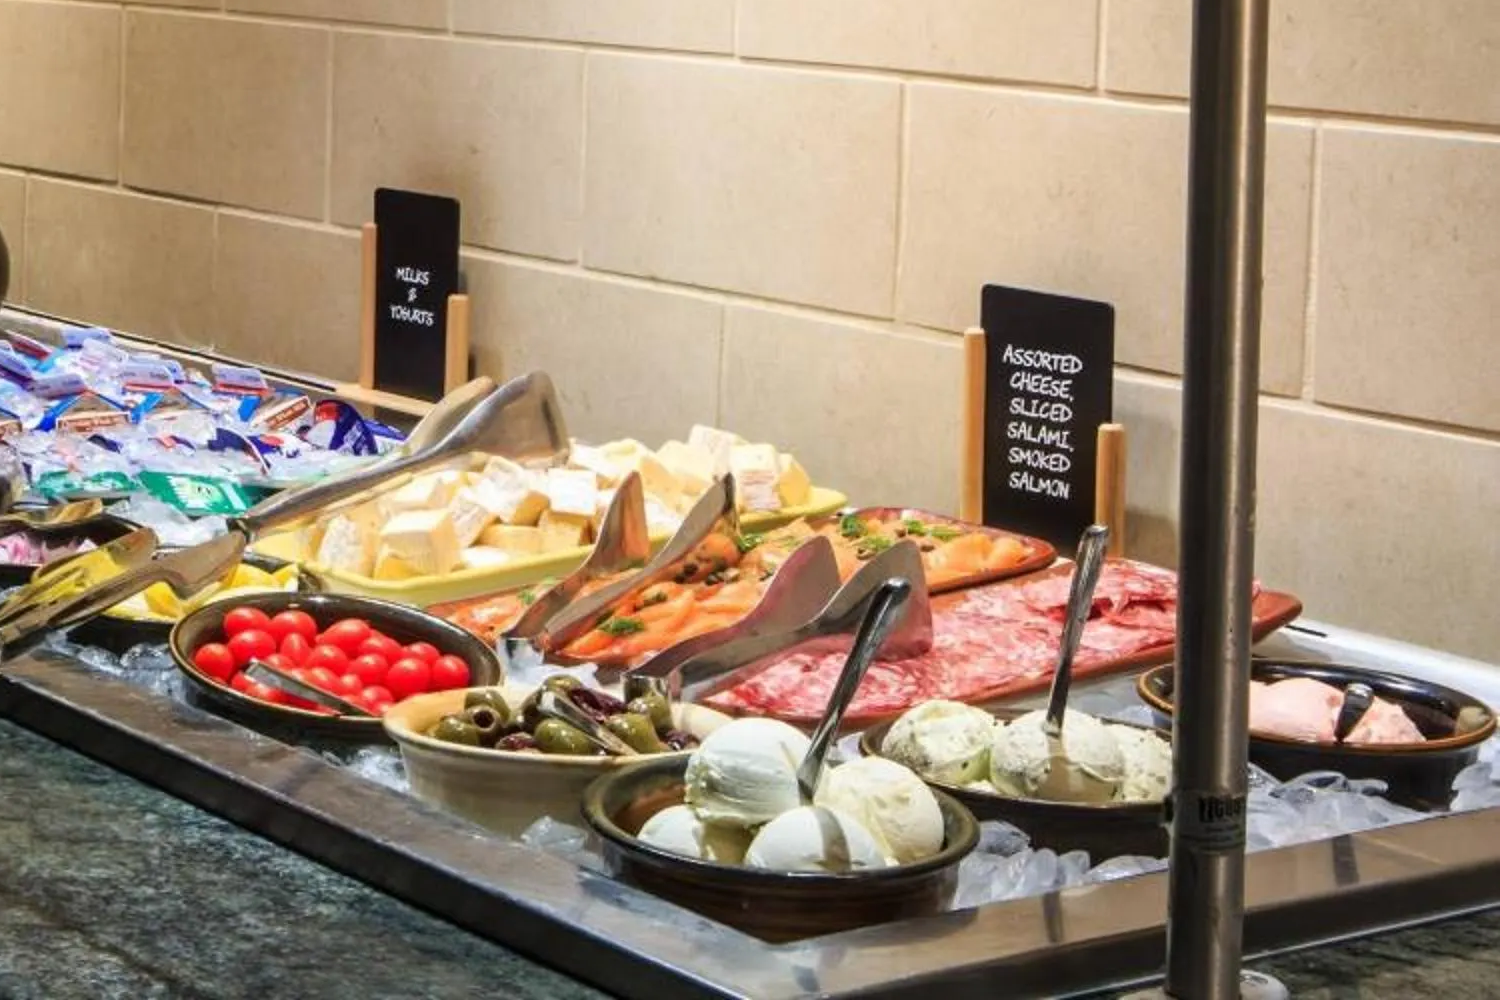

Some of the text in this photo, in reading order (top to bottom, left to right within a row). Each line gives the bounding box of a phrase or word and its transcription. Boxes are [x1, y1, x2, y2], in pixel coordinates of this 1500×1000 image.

[396, 267, 430, 285] MILKS
[389, 305, 435, 327] YOGURTS
[1002, 344, 1084, 374] ASSORTED
[1010, 372, 1074, 402] CHEESE,
[1009, 398, 1072, 422] SLICED
[1007, 422, 1074, 452] SALAMI,
[1009, 447, 1071, 472] SMOKED
[1009, 472, 1069, 499] SALMON
